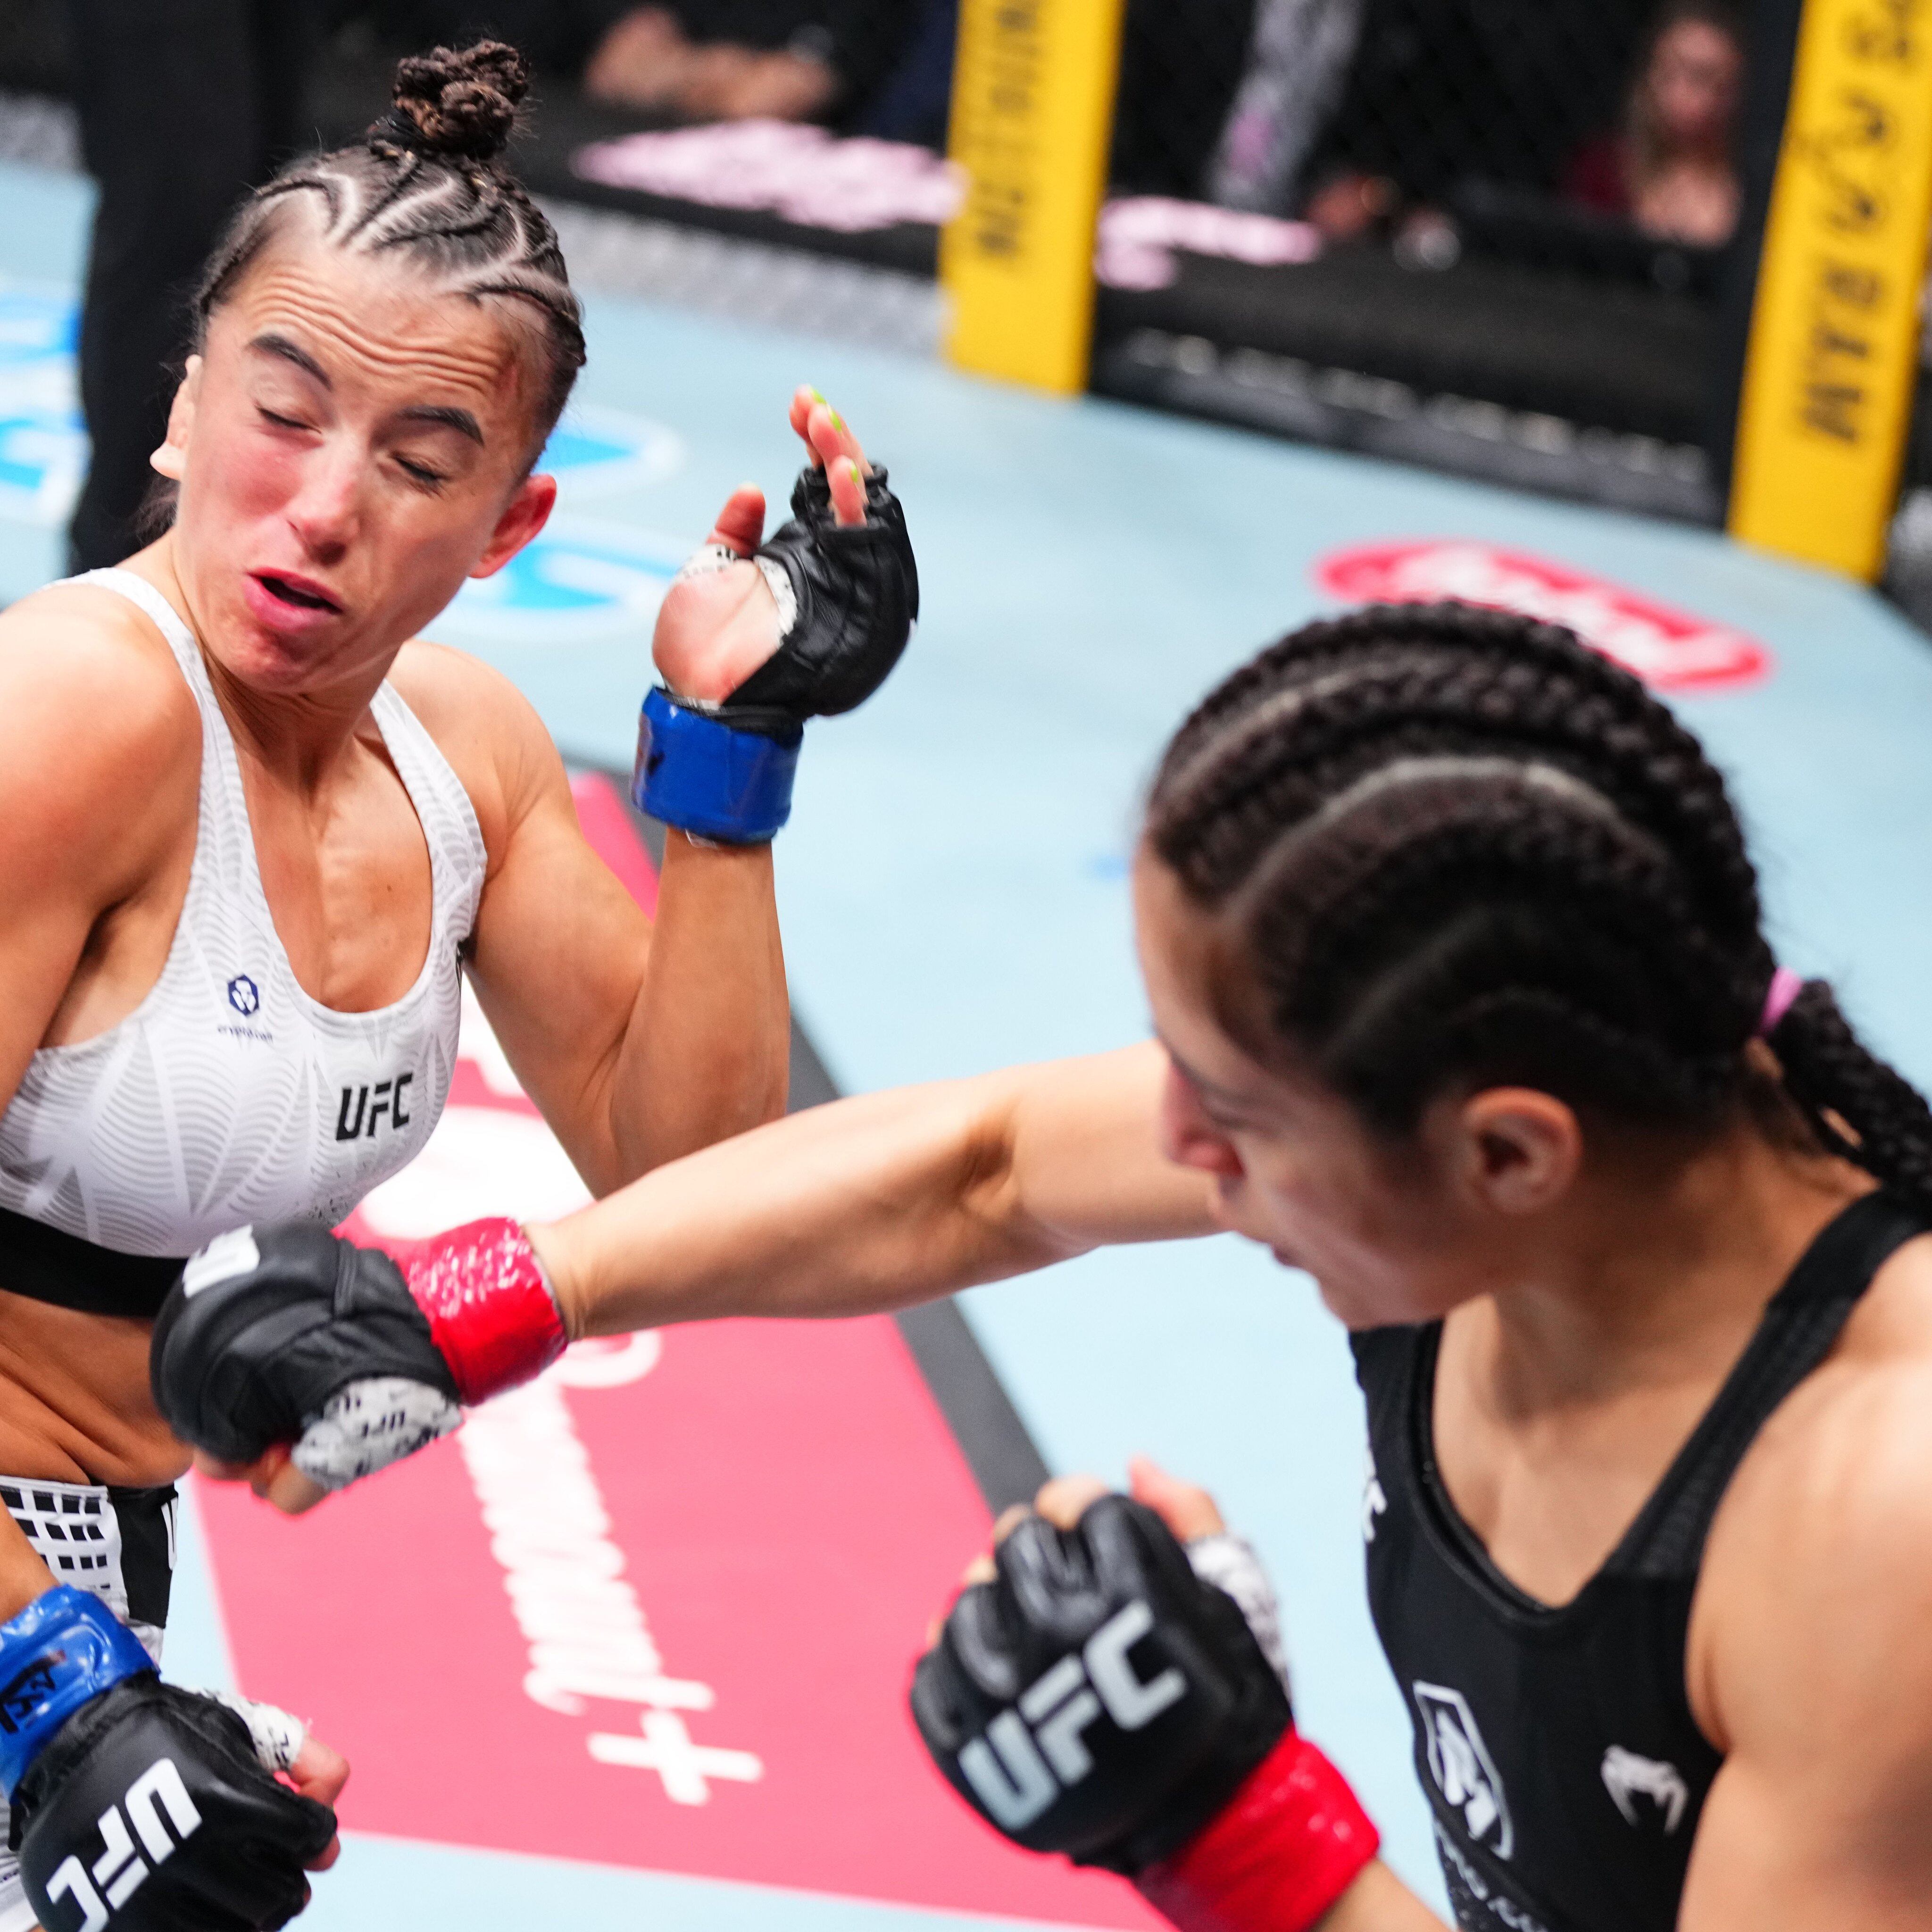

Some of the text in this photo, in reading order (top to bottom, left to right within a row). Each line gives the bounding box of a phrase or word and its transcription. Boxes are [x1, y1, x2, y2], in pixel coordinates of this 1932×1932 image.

[335, 1072, 413, 1142] UFC
[957, 1601, 1187, 1830] UFC
[45, 1757, 203, 1932] UFC
